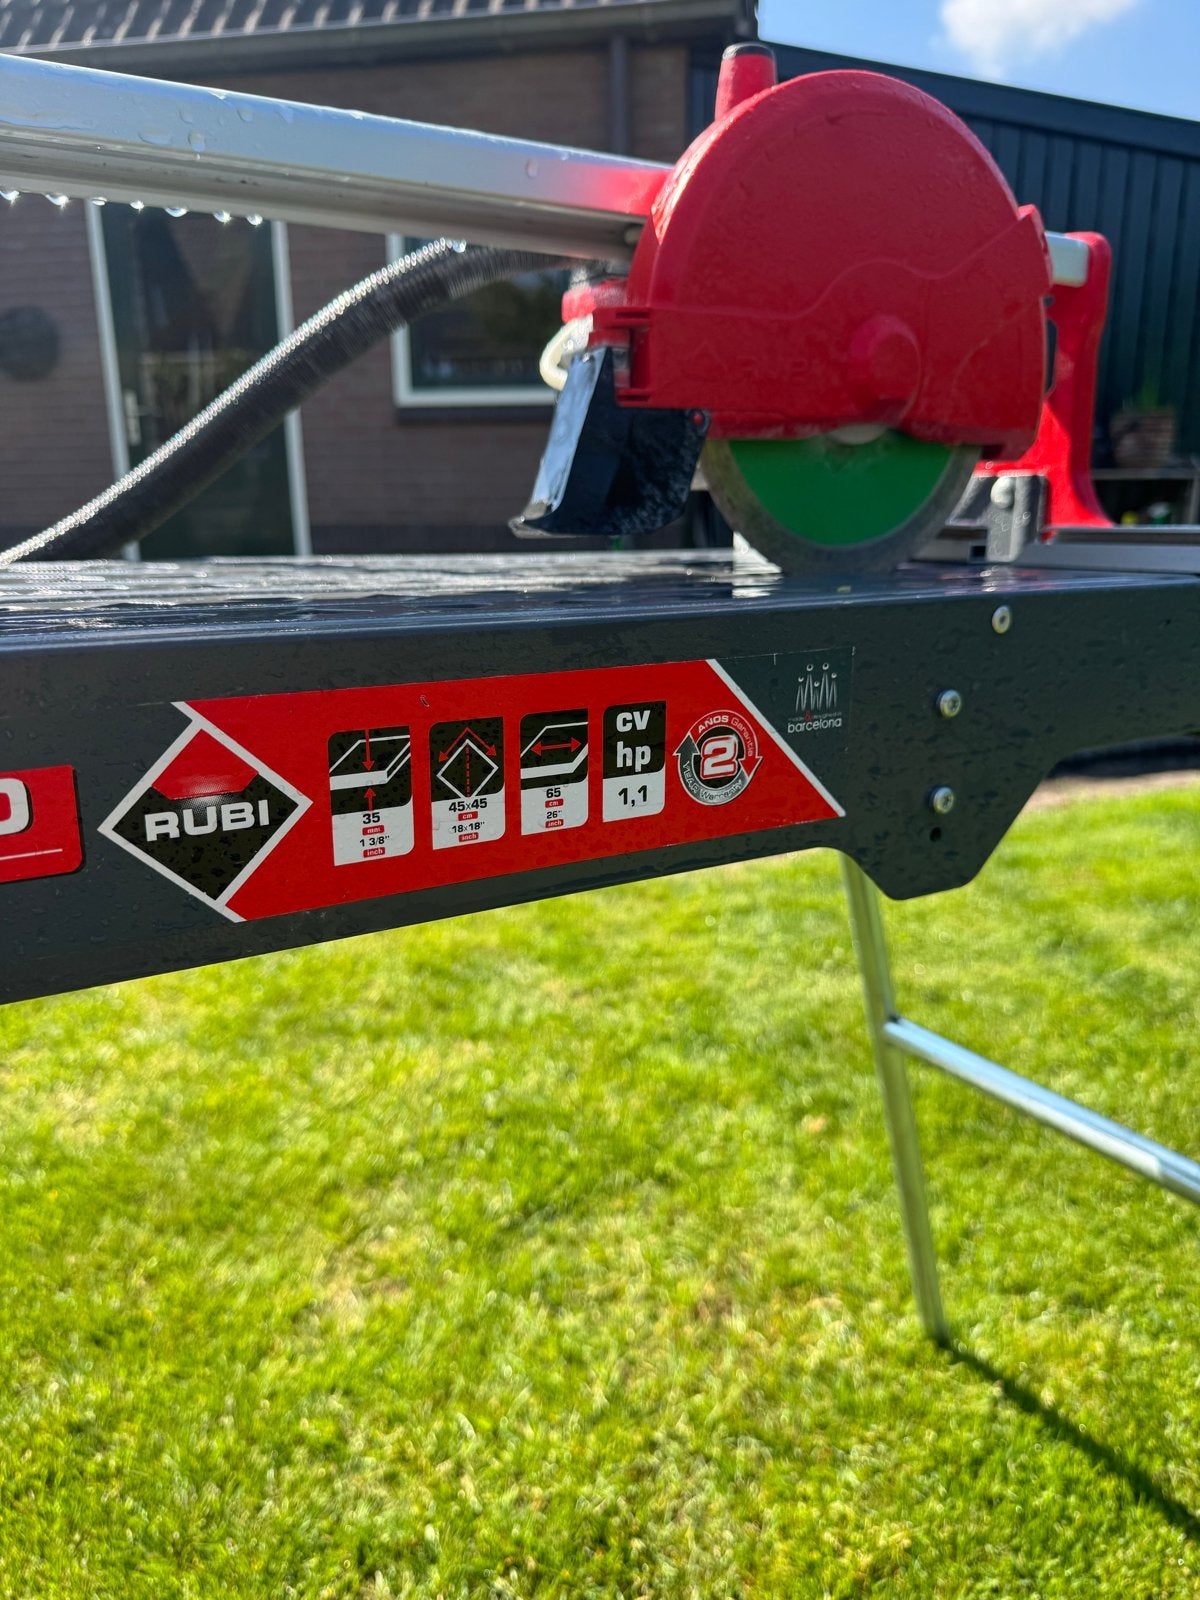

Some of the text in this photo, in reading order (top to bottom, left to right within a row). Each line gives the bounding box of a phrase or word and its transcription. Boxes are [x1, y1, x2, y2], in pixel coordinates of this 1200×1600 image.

[616, 710, 650, 733] cv
[787, 718, 843, 733] barcelona
[616, 741, 652, 772] hp
[701, 735, 738, 780] 2
[682, 761, 700, 793] YEAR
[546, 787, 561, 798] 65
[618, 785, 649, 807] 1,1
[448, 798, 488, 812] 45x45
[145, 799, 270, 842] RUBI
[362, 812, 381, 824] 35
[548, 819, 562, 827] inch
[367, 826, 381, 834] mm
[360, 839, 365, 847] 1
[367, 848, 383, 856] inch
